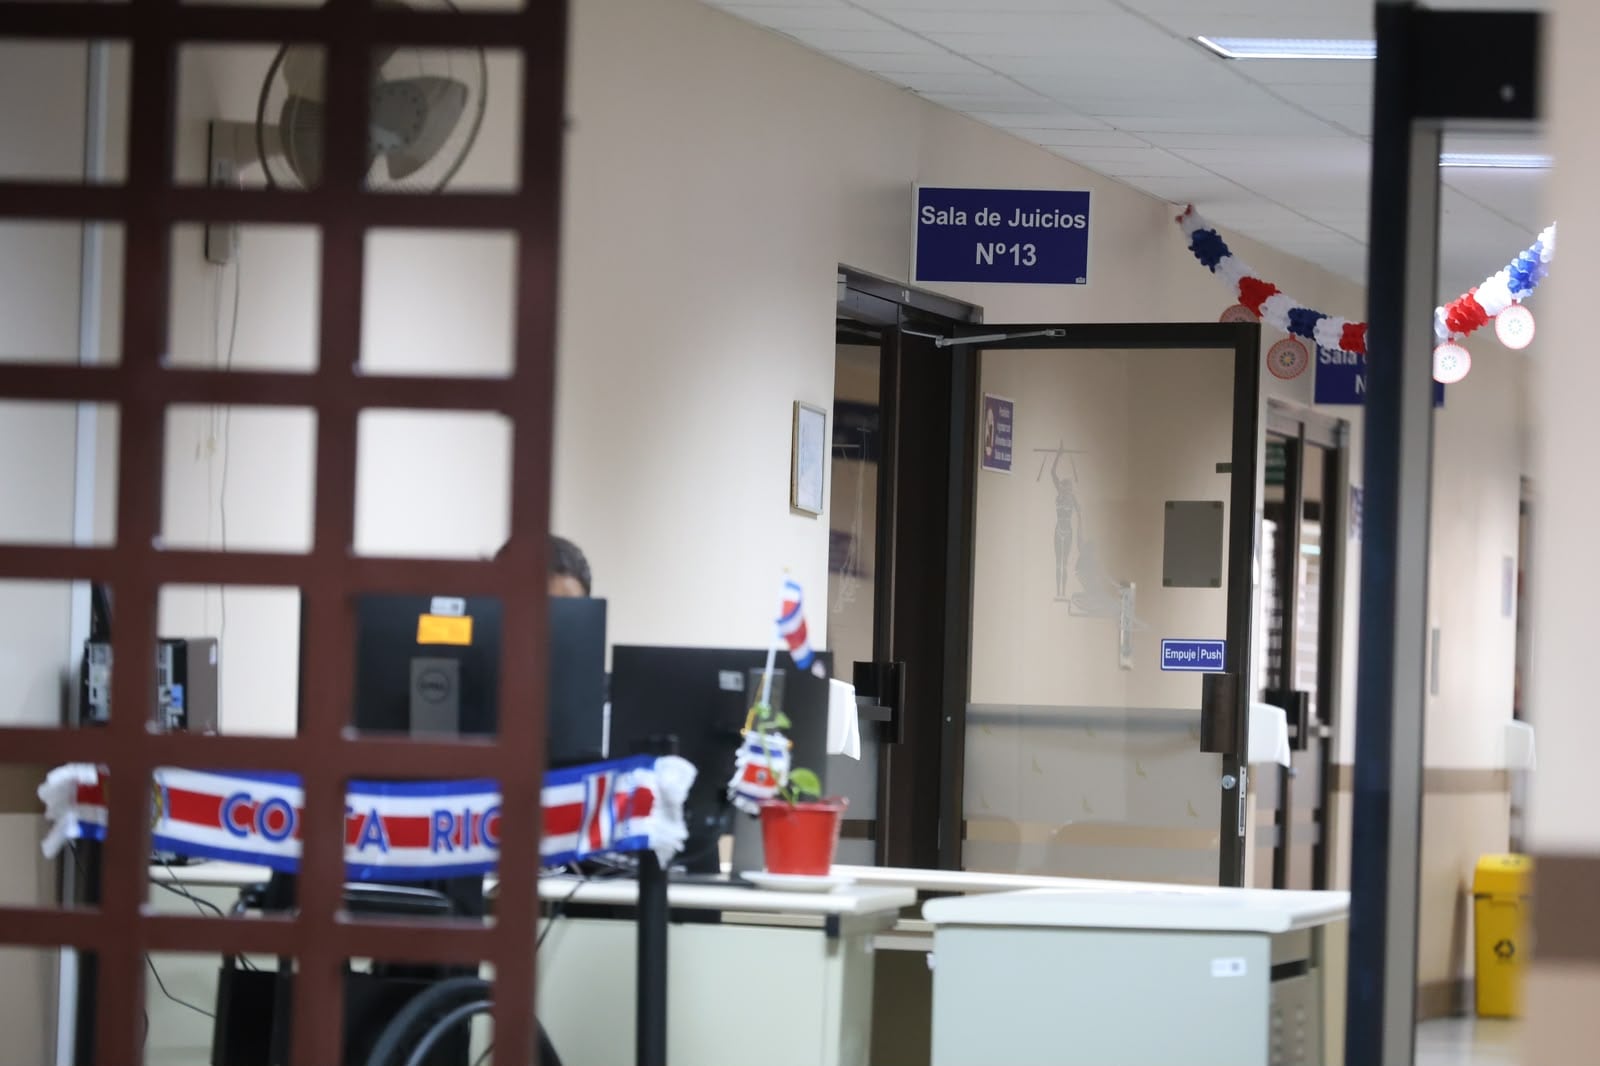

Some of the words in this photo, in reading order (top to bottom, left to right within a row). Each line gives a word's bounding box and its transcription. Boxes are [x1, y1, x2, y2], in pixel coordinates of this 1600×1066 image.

[921, 205, 967, 225] Sala
[975, 208, 1001, 226] de
[1008, 208, 1086, 229] Juicios
[1165, 648, 1197, 661] Empuje
[1200, 648, 1222, 660] Push
[221, 792, 389, 853] COA
[431, 807, 501, 853] RIC
